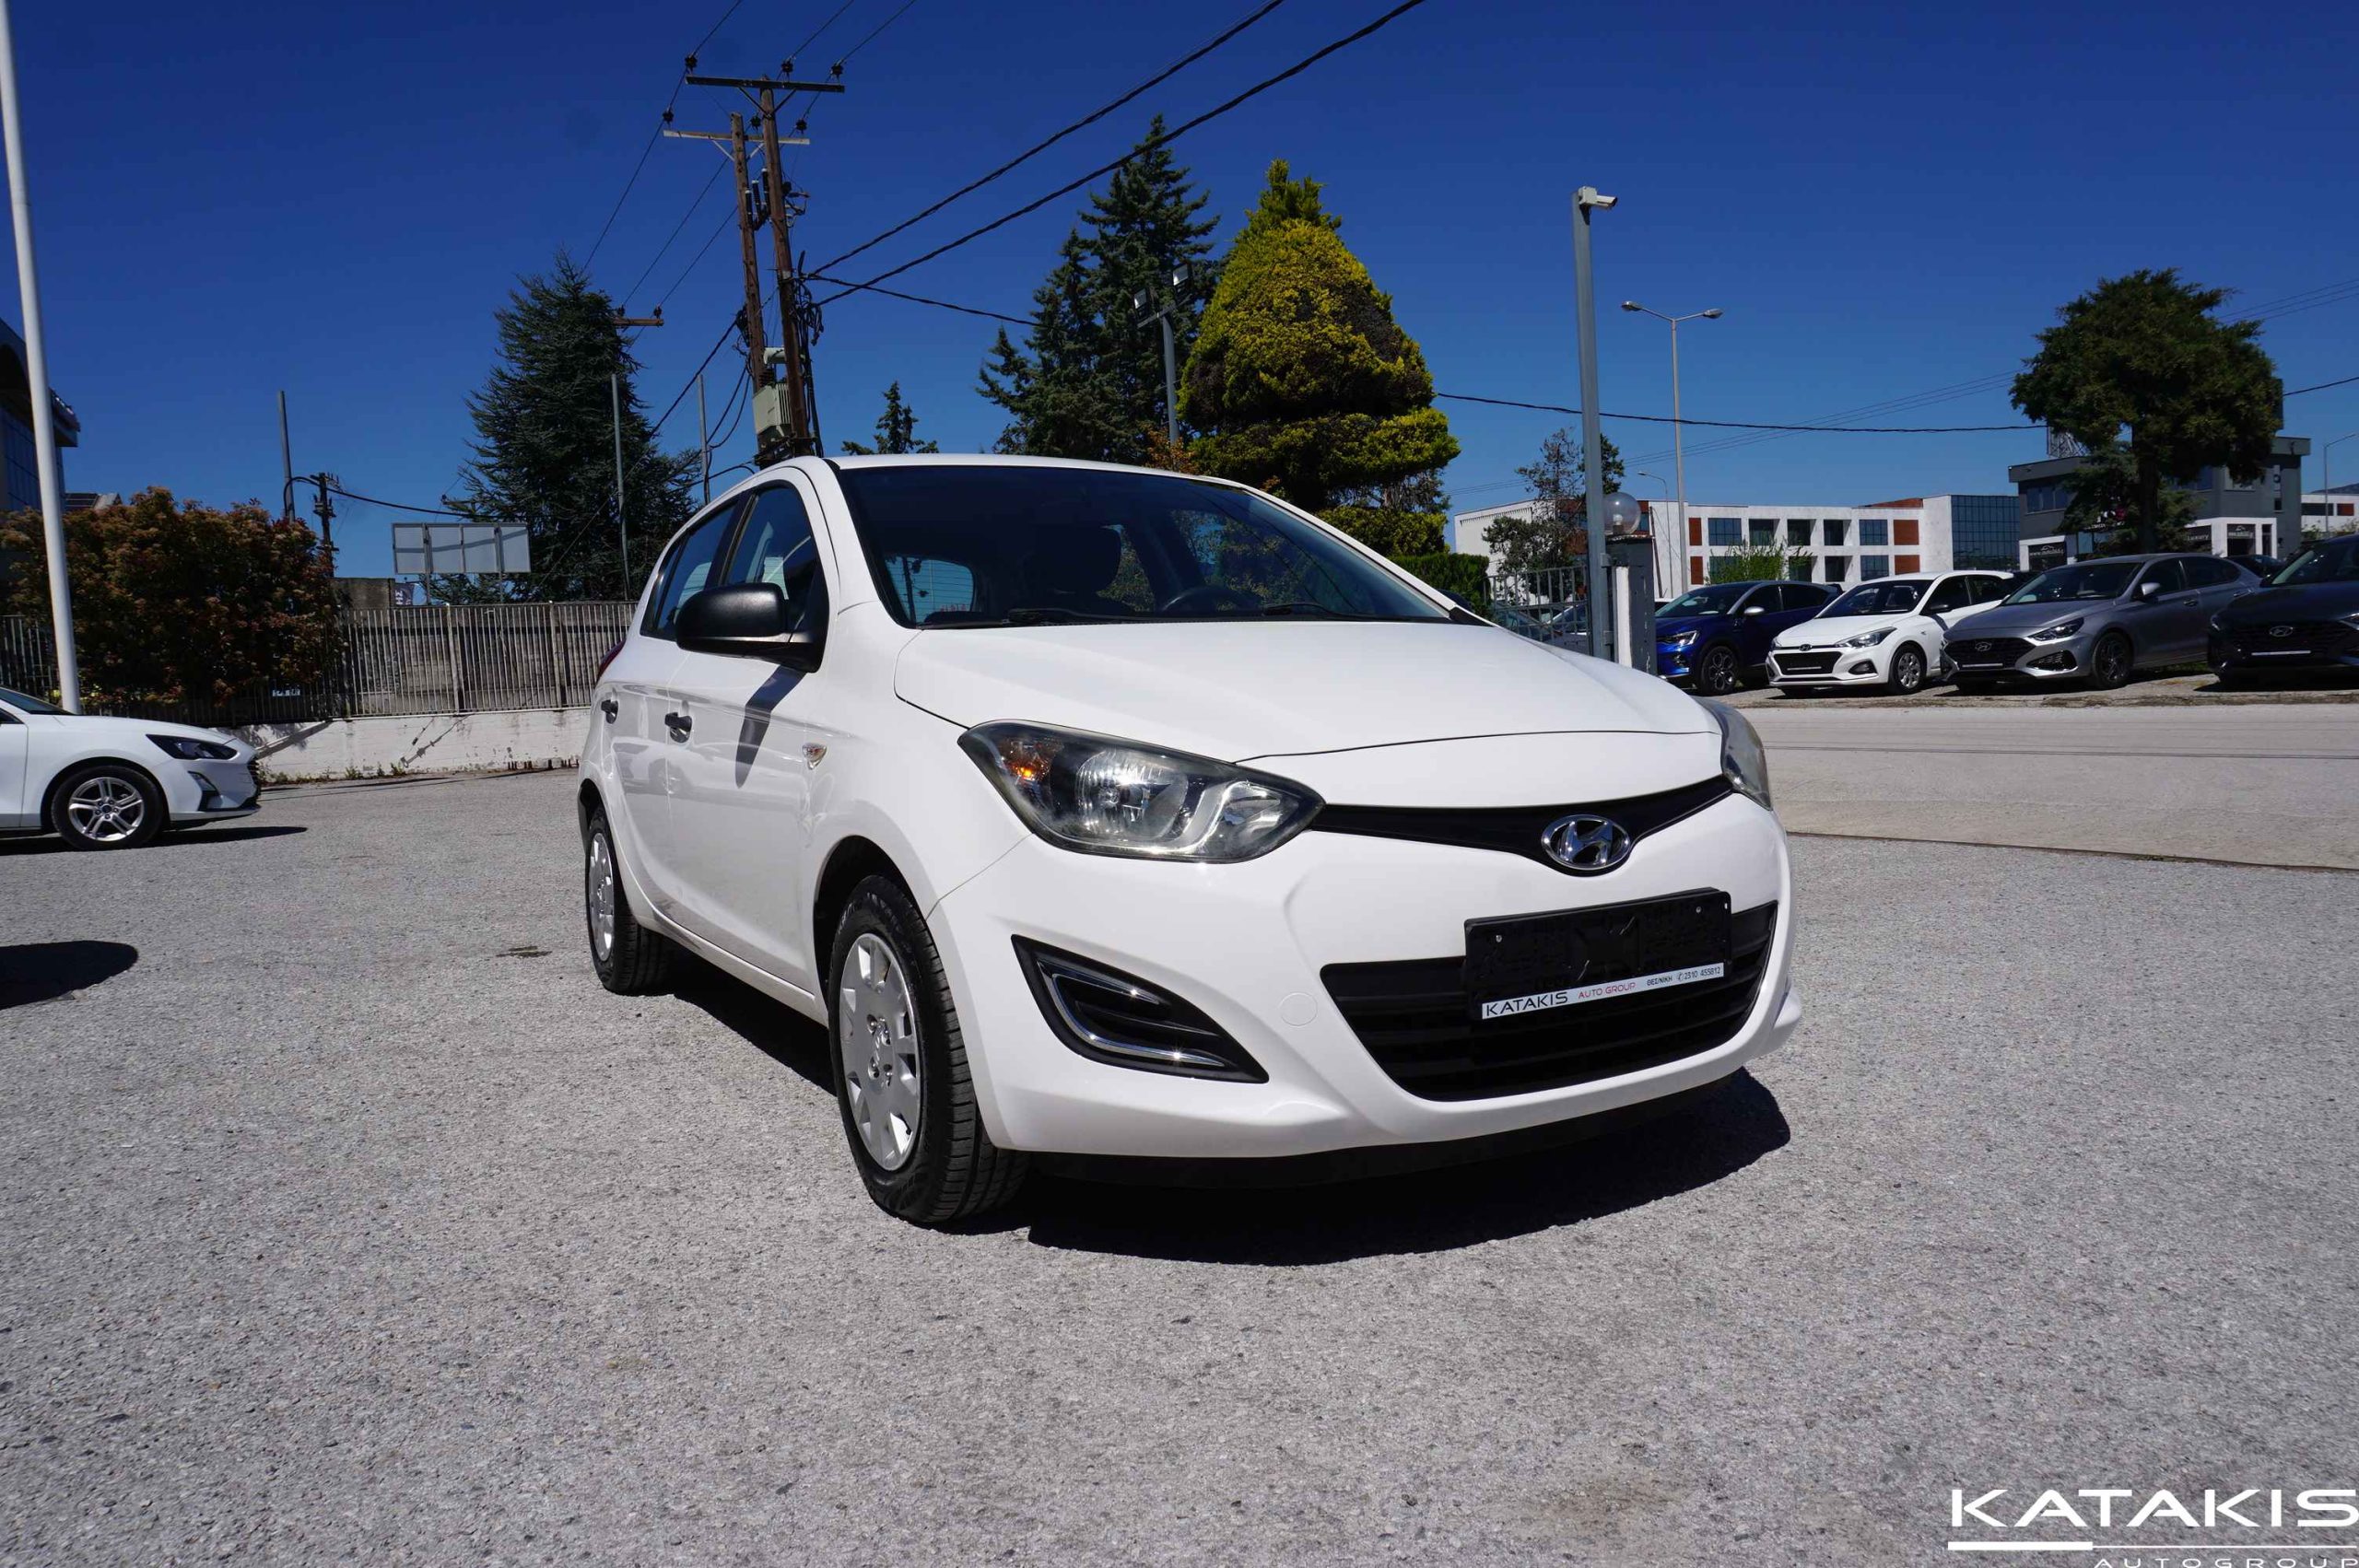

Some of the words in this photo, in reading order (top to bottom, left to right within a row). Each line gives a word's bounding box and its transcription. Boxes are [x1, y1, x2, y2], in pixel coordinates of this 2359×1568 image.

[1486, 991, 1568, 1017] KATAKIS
[1578, 989, 1603, 1000] AUTO
[1605, 982, 1637, 995] GROUP
